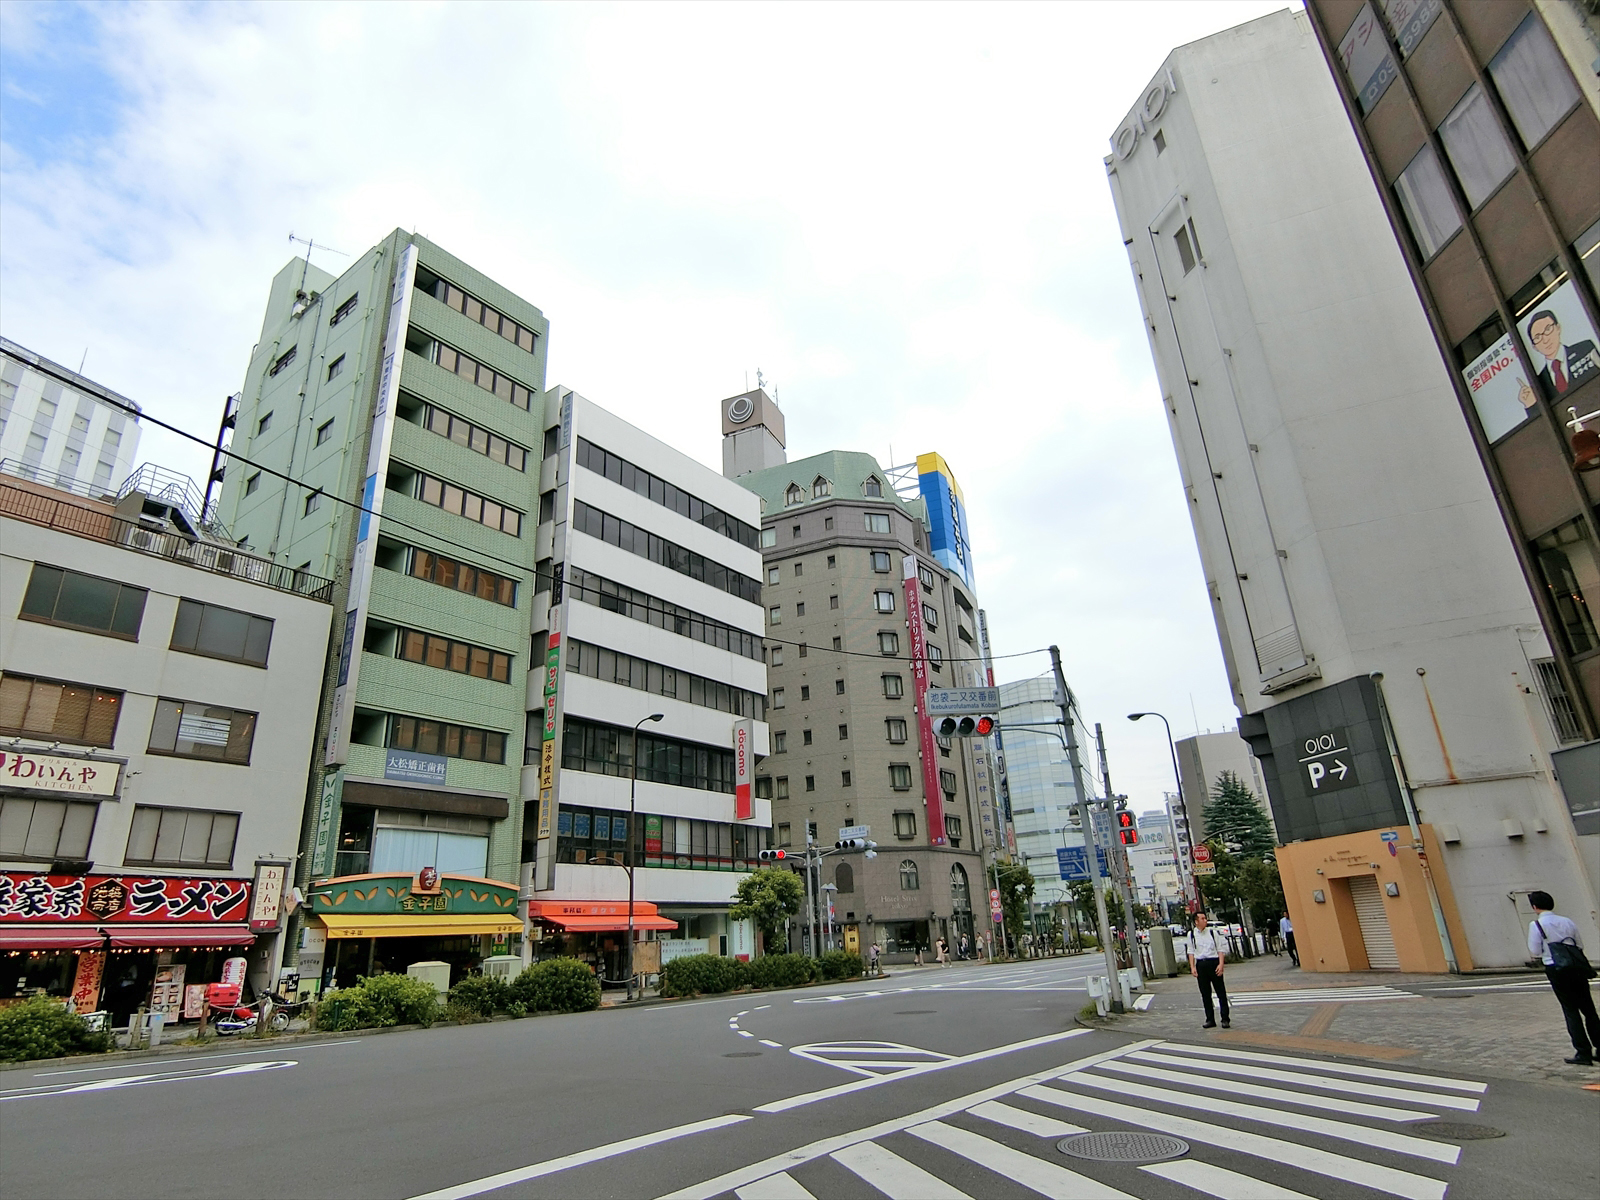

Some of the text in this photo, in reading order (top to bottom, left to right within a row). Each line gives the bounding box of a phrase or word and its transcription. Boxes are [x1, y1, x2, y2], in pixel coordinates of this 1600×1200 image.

[547, 666, 557, 732] サイゼリヤ
[931, 691, 997, 703] 池袋二又交番前
[388, 756, 446, 775] 大松矯正歯科
[738, 728, 746, 776] docomo
[8, 755, 97, 784] わいんや
[1308, 762, 1325, 788] P
[34, 780, 94, 791] KITCHEN
[318, 793, 334, 846] 金子園
[1139, 832, 1163, 845] ARCO
[93, 886, 122, 898] 池袋
[129, 879, 247, 919] ラーメン
[262, 870, 277, 916] わいんや
[400, 895, 448, 911] 金子園
[75, 955, 98, 1001] 営業中
